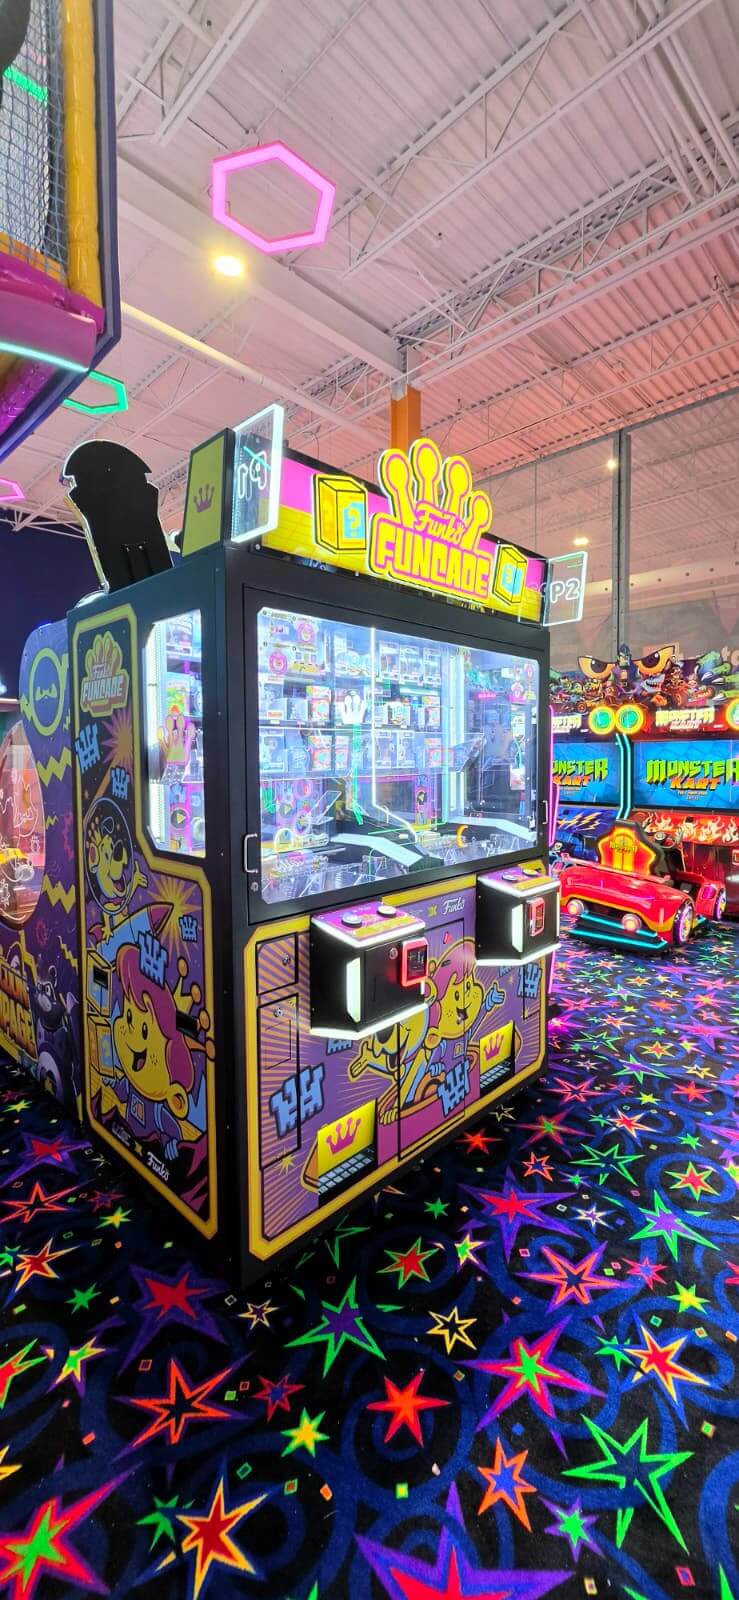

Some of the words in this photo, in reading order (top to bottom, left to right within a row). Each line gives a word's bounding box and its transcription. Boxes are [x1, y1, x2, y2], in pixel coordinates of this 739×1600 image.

[414, 502, 464, 545] Funko
[376, 521, 491, 598] FUNCADE
[550, 578, 580, 603] P2
[83, 675, 124, 703] FUNCADE
[552, 758, 609, 781] ONSTER
[646, 758, 739, 784] MONSTER
[670, 777, 721, 791] KART
[442, 896, 465, 915] Funko
[147, 1151, 169, 1182] Funko
